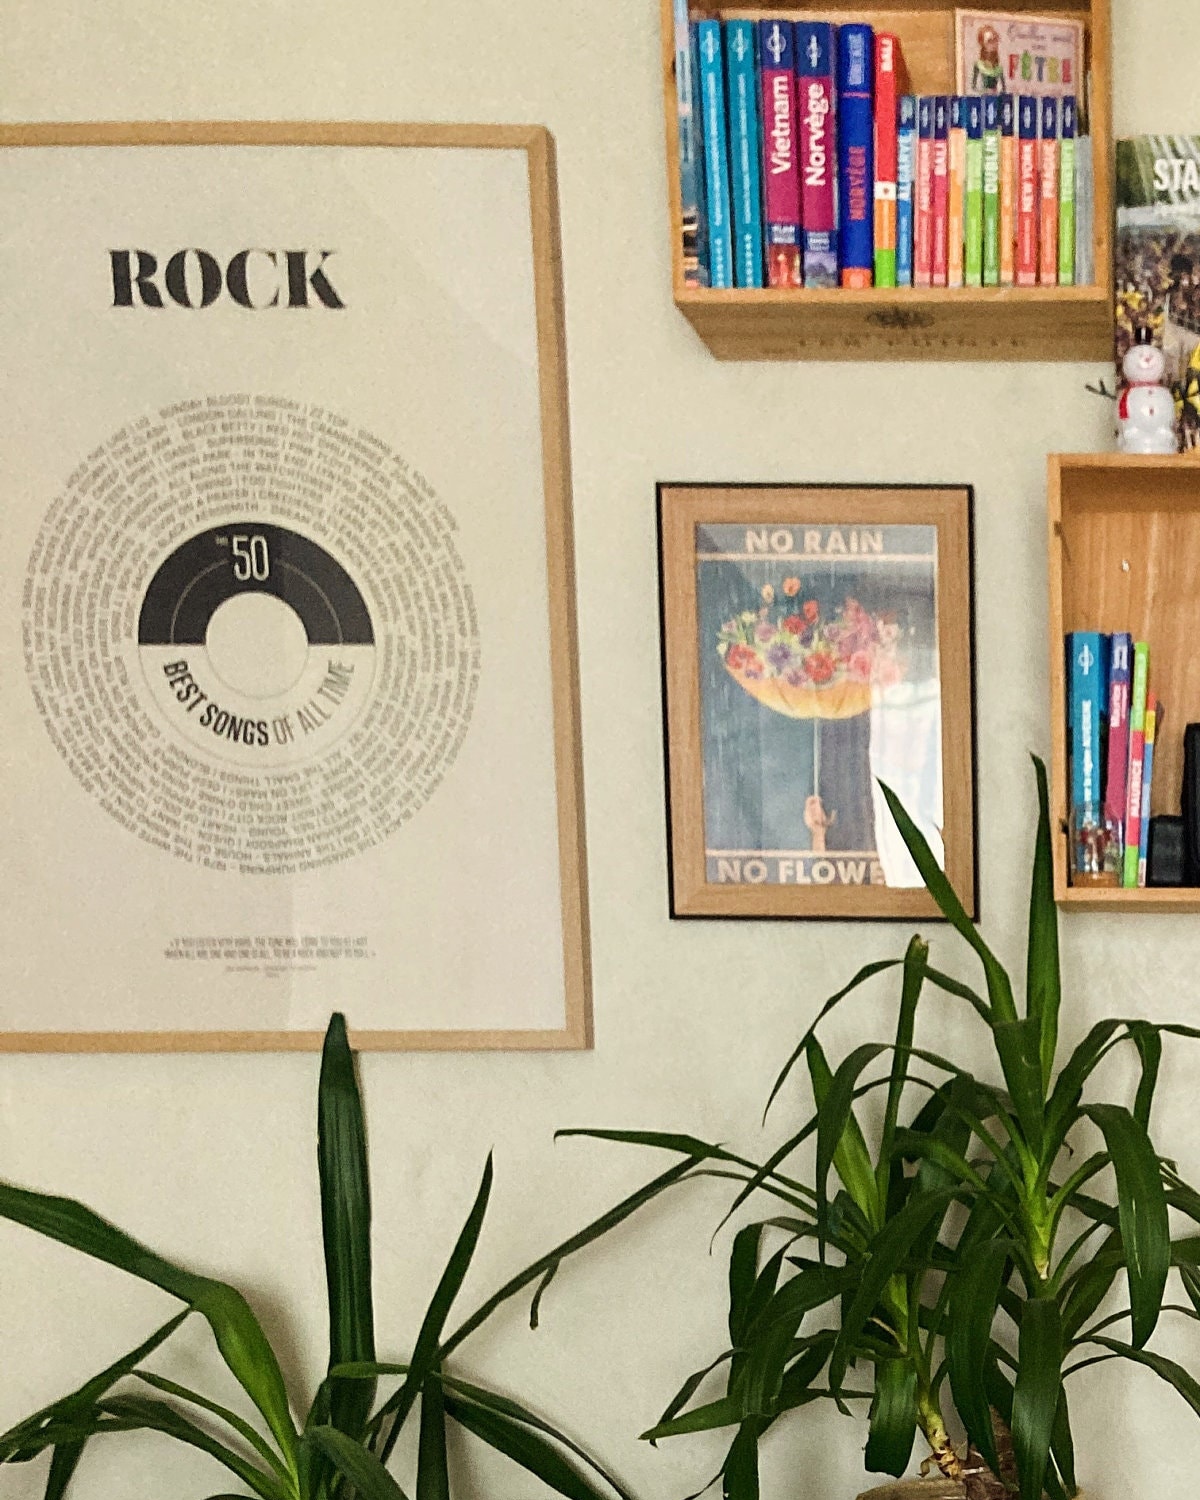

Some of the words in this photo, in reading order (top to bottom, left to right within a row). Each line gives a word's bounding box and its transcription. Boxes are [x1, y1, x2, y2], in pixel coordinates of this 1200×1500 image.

[771, 76, 791, 174] Vietnam
[805, 84, 829, 186] Norvège
[935, 143, 946, 176] BALI
[985, 136, 998, 193] DUBLIN
[109, 248, 347, 310] ROCK
[232, 534, 270, 582] 50
[745, 529, 797, 554] NO
[803, 529, 884, 554] RAIN
[163, 660, 207, 713] BEST
[199, 703, 270, 747] SONGS
[271, 718, 295, 744] OF
[296, 703, 326, 738] ALL
[317, 658, 356, 706] TIME
[1131, 759, 1142, 818] MAURICE
[717, 857, 771, 884] NO
[778, 857, 887, 885] FLOWE
